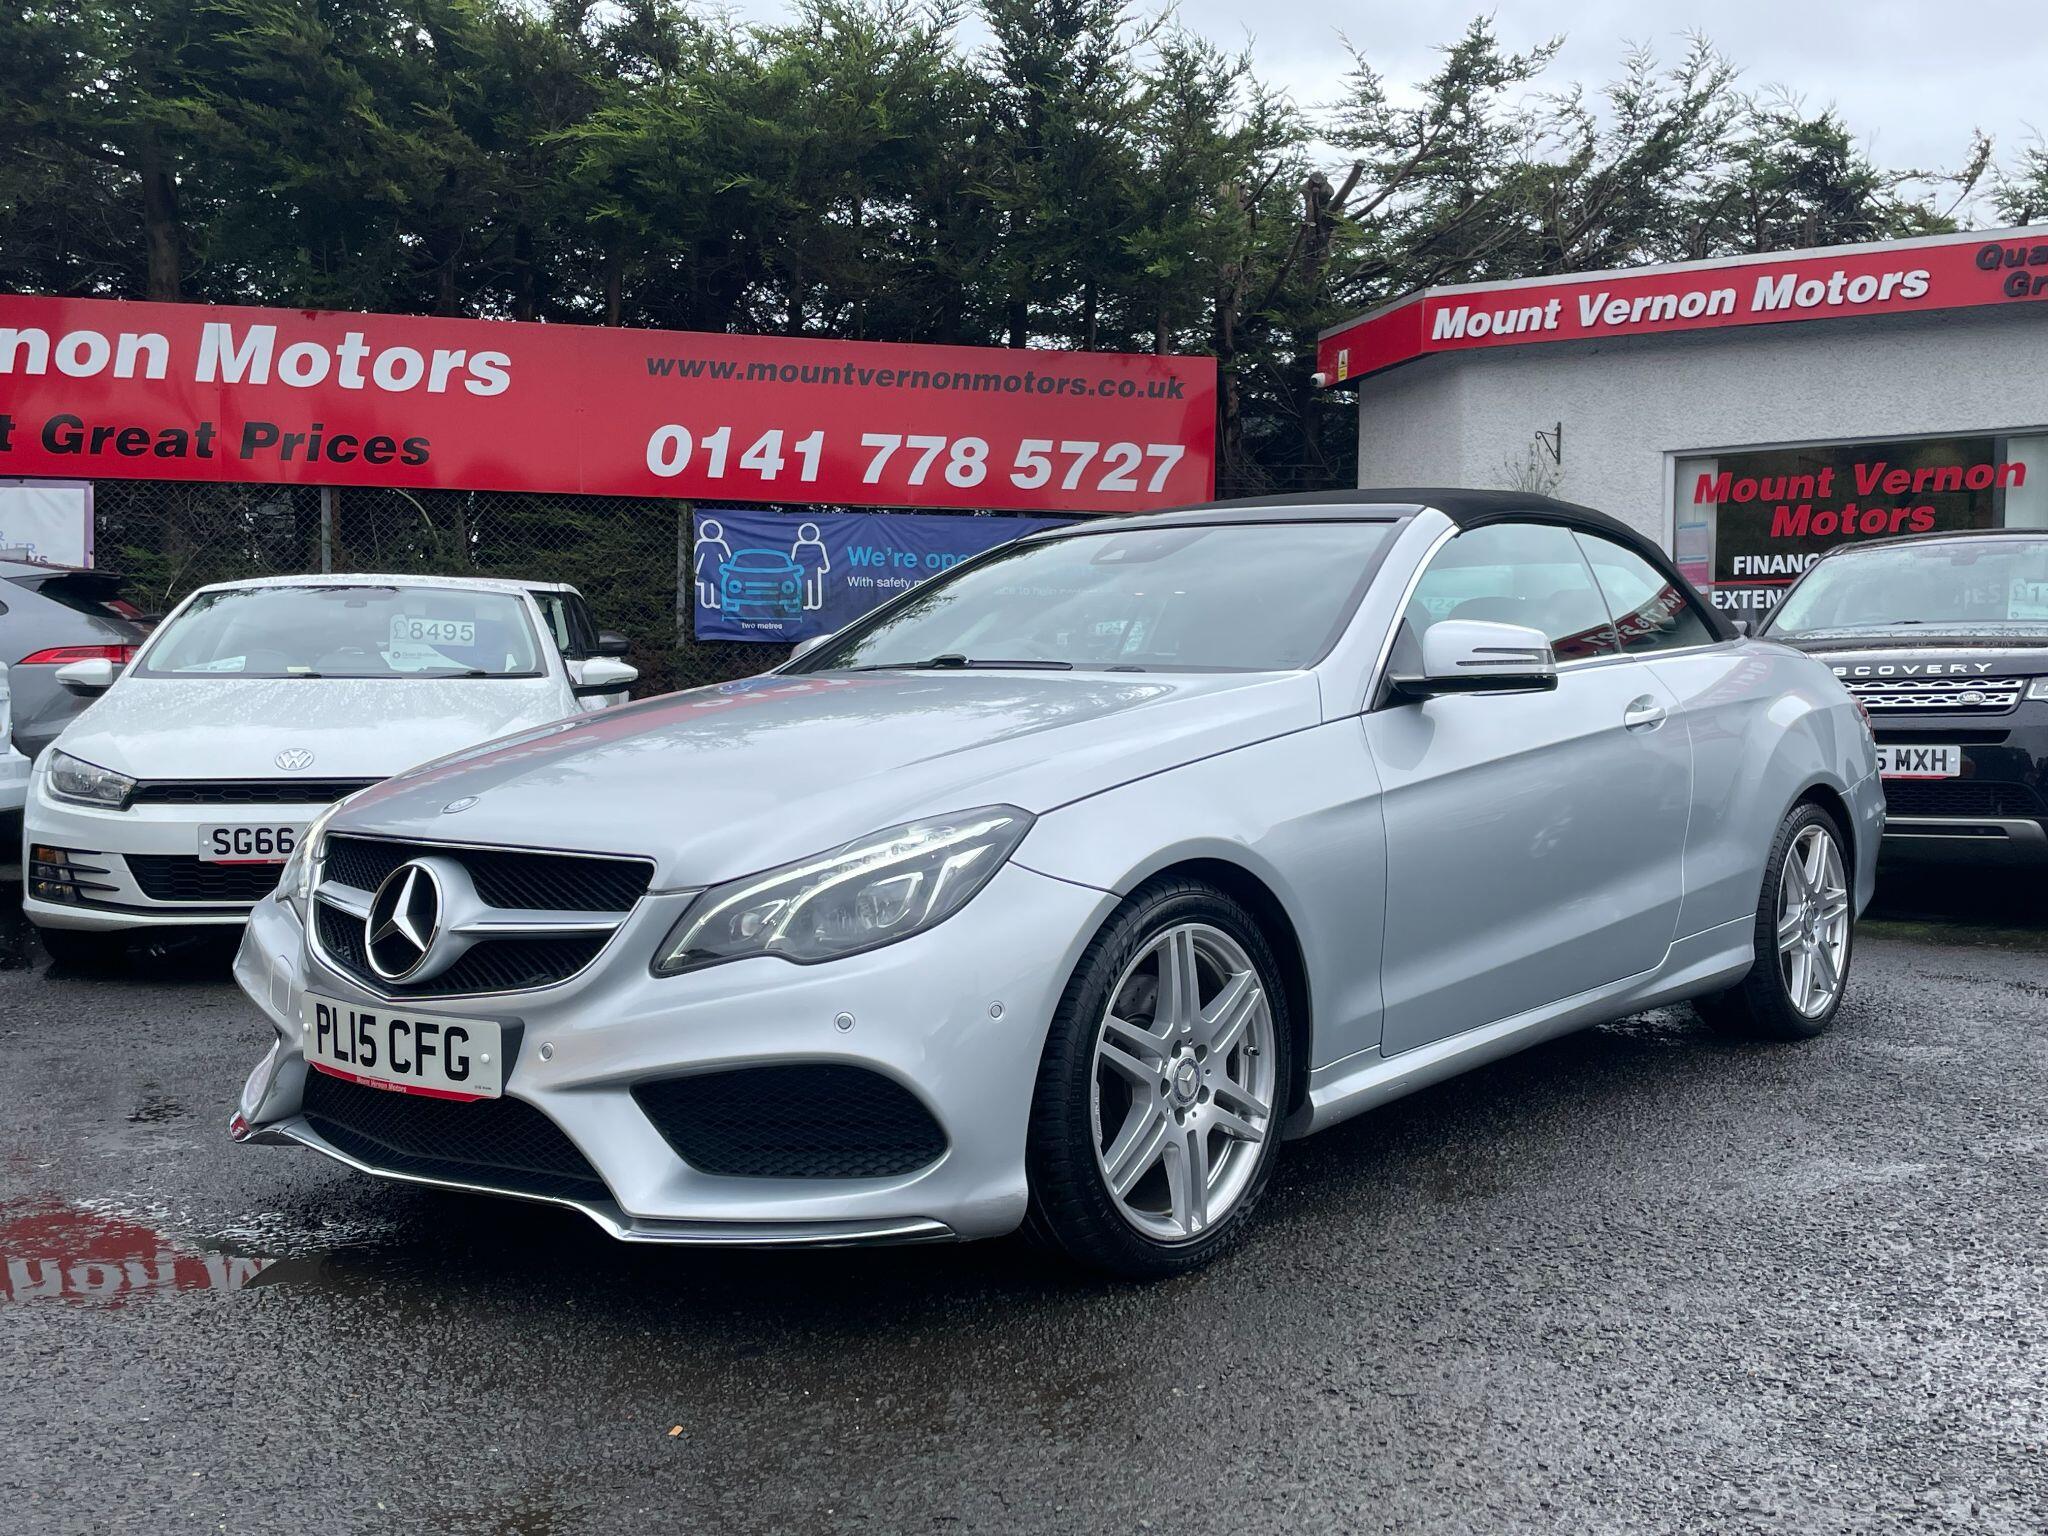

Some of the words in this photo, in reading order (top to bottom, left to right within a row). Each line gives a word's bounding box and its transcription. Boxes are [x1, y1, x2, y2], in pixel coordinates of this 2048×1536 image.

[1432, 298, 1562, 340] Mount
[1579, 281, 1737, 328] Vernon
[1750, 268, 1931, 313] Motors
[0, 327, 170, 380] non
[195, 323, 511, 396] Motors
[646, 357, 1185, 400] www.mountvernonmotors.co.uk
[41, 414, 216, 459] Great
[240, 421, 431, 465] Prices
[646, 424, 824, 483] 0141
[861, 433, 989, 488] 778
[1009, 439, 1185, 493] 5727
[1694, 467, 1834, 504] Mount
[1854, 462, 2027, 496] Vernon
[1770, 503, 1936, 537] Motors
[847, 576, 873, 588] With
[877, 576, 912, 591] safety
[757, 622, 783, 630] metres
[1895, 749, 1947, 771] MXH
[212, 828, 295, 855] SG66
[315, 1002, 377, 1068] PL15
[389, 1018, 470, 1082] CFG
